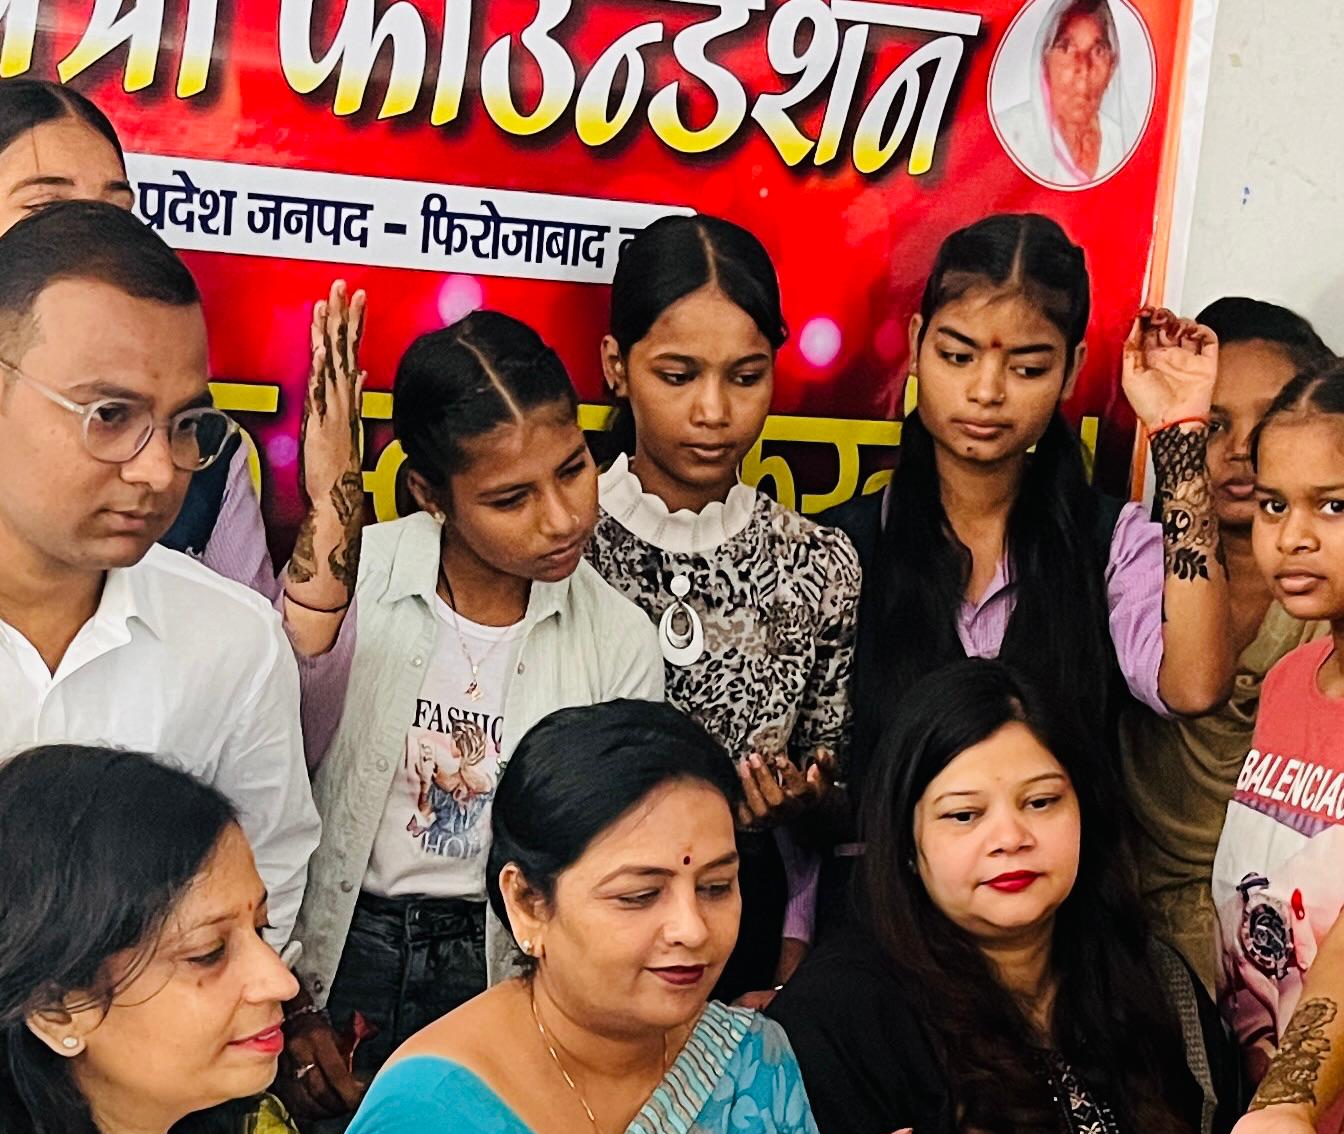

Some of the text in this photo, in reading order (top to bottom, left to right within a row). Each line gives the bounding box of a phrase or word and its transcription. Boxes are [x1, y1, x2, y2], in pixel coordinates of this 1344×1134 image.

[278, 0, 982, 176] फाउन्डशन
[138, 170, 236, 235] प्रदेश
[248, 192, 374, 247] जनपद
[420, 193, 611, 268] फिरोजाबाद
